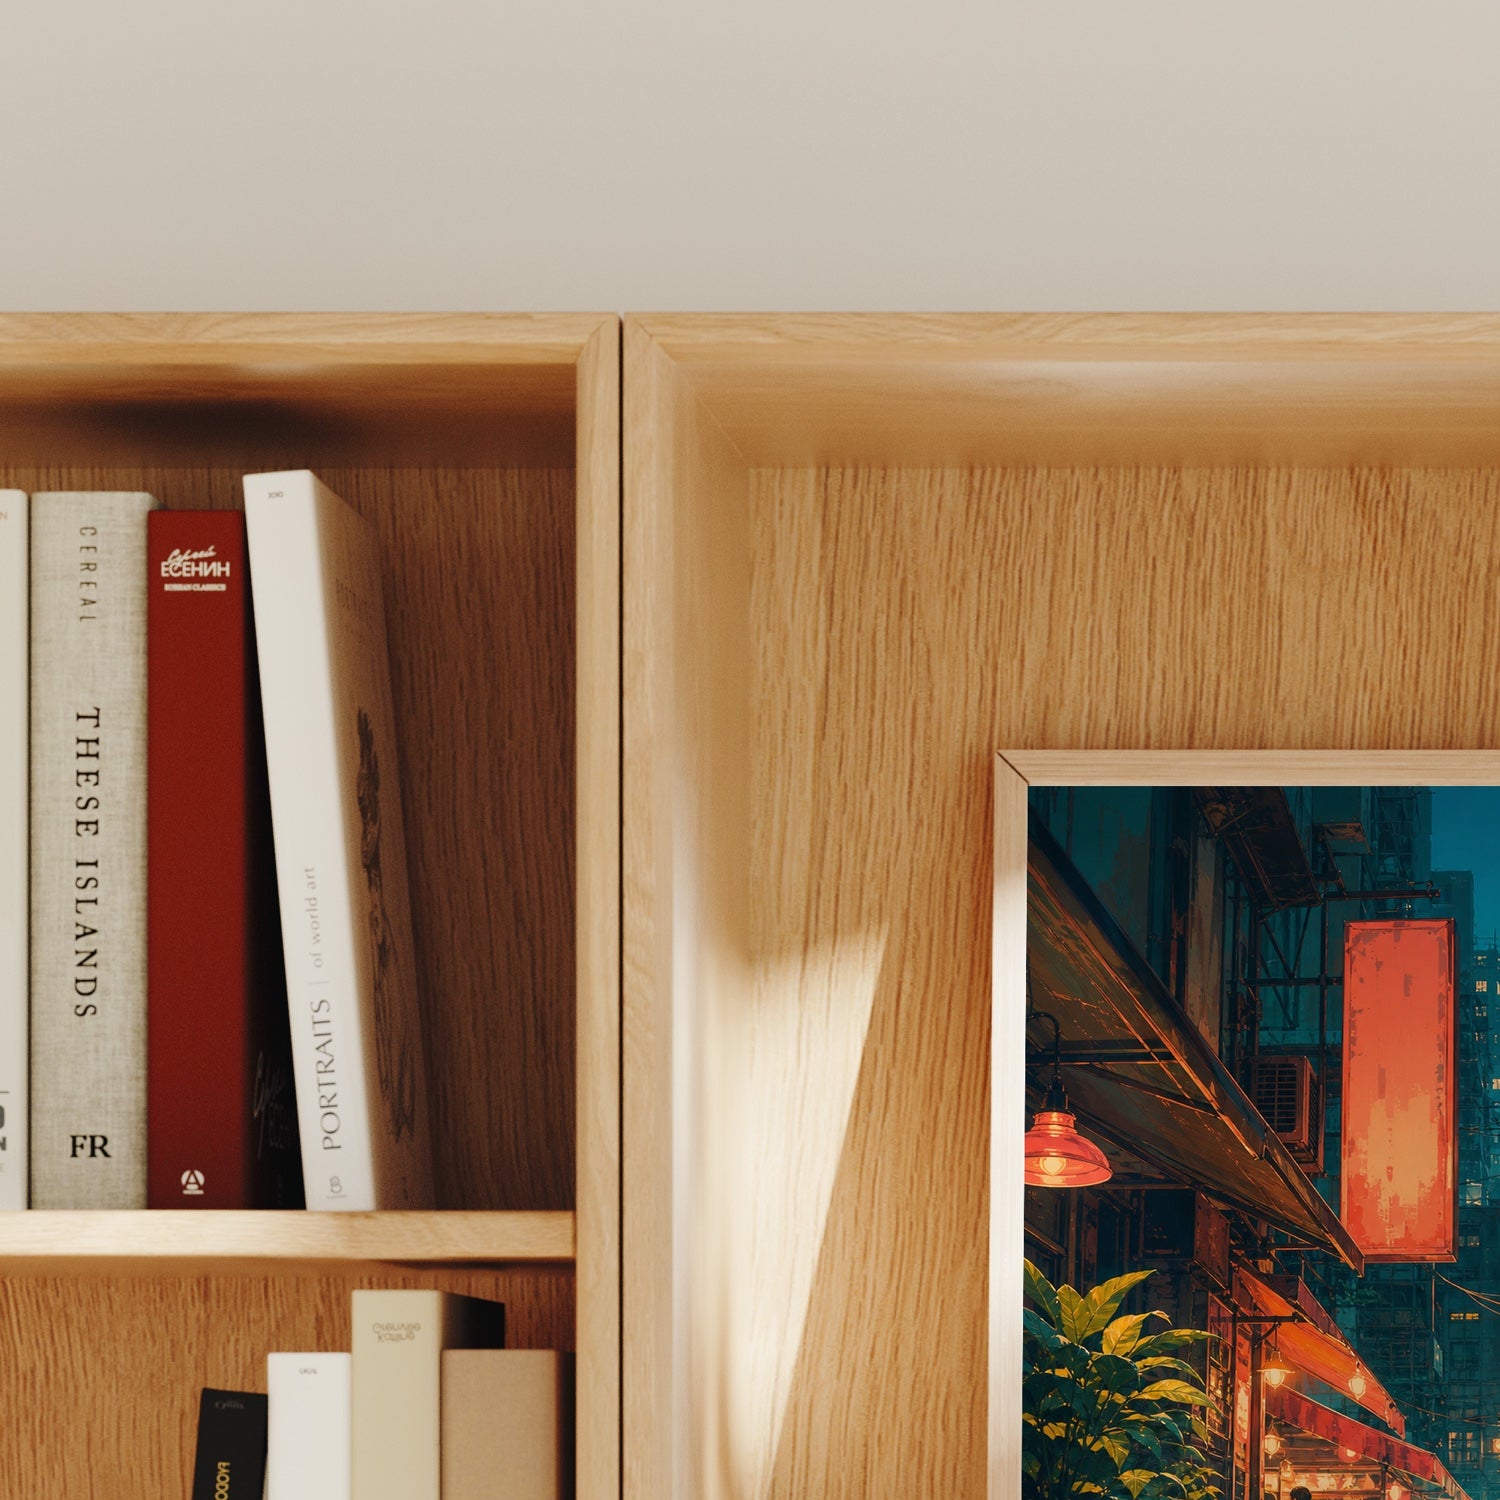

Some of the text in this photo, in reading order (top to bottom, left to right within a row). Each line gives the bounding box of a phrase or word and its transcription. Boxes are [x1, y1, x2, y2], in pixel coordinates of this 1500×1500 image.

[79, 526, 98, 622] CEREAL
[160, 561, 230, 577] ЕСЕНИН
[74, 706, 101, 1018] THESE ISLANDS
[304, 866, 342, 1151] PORTRAITS of world art
[70, 1134, 112, 1158] FR
